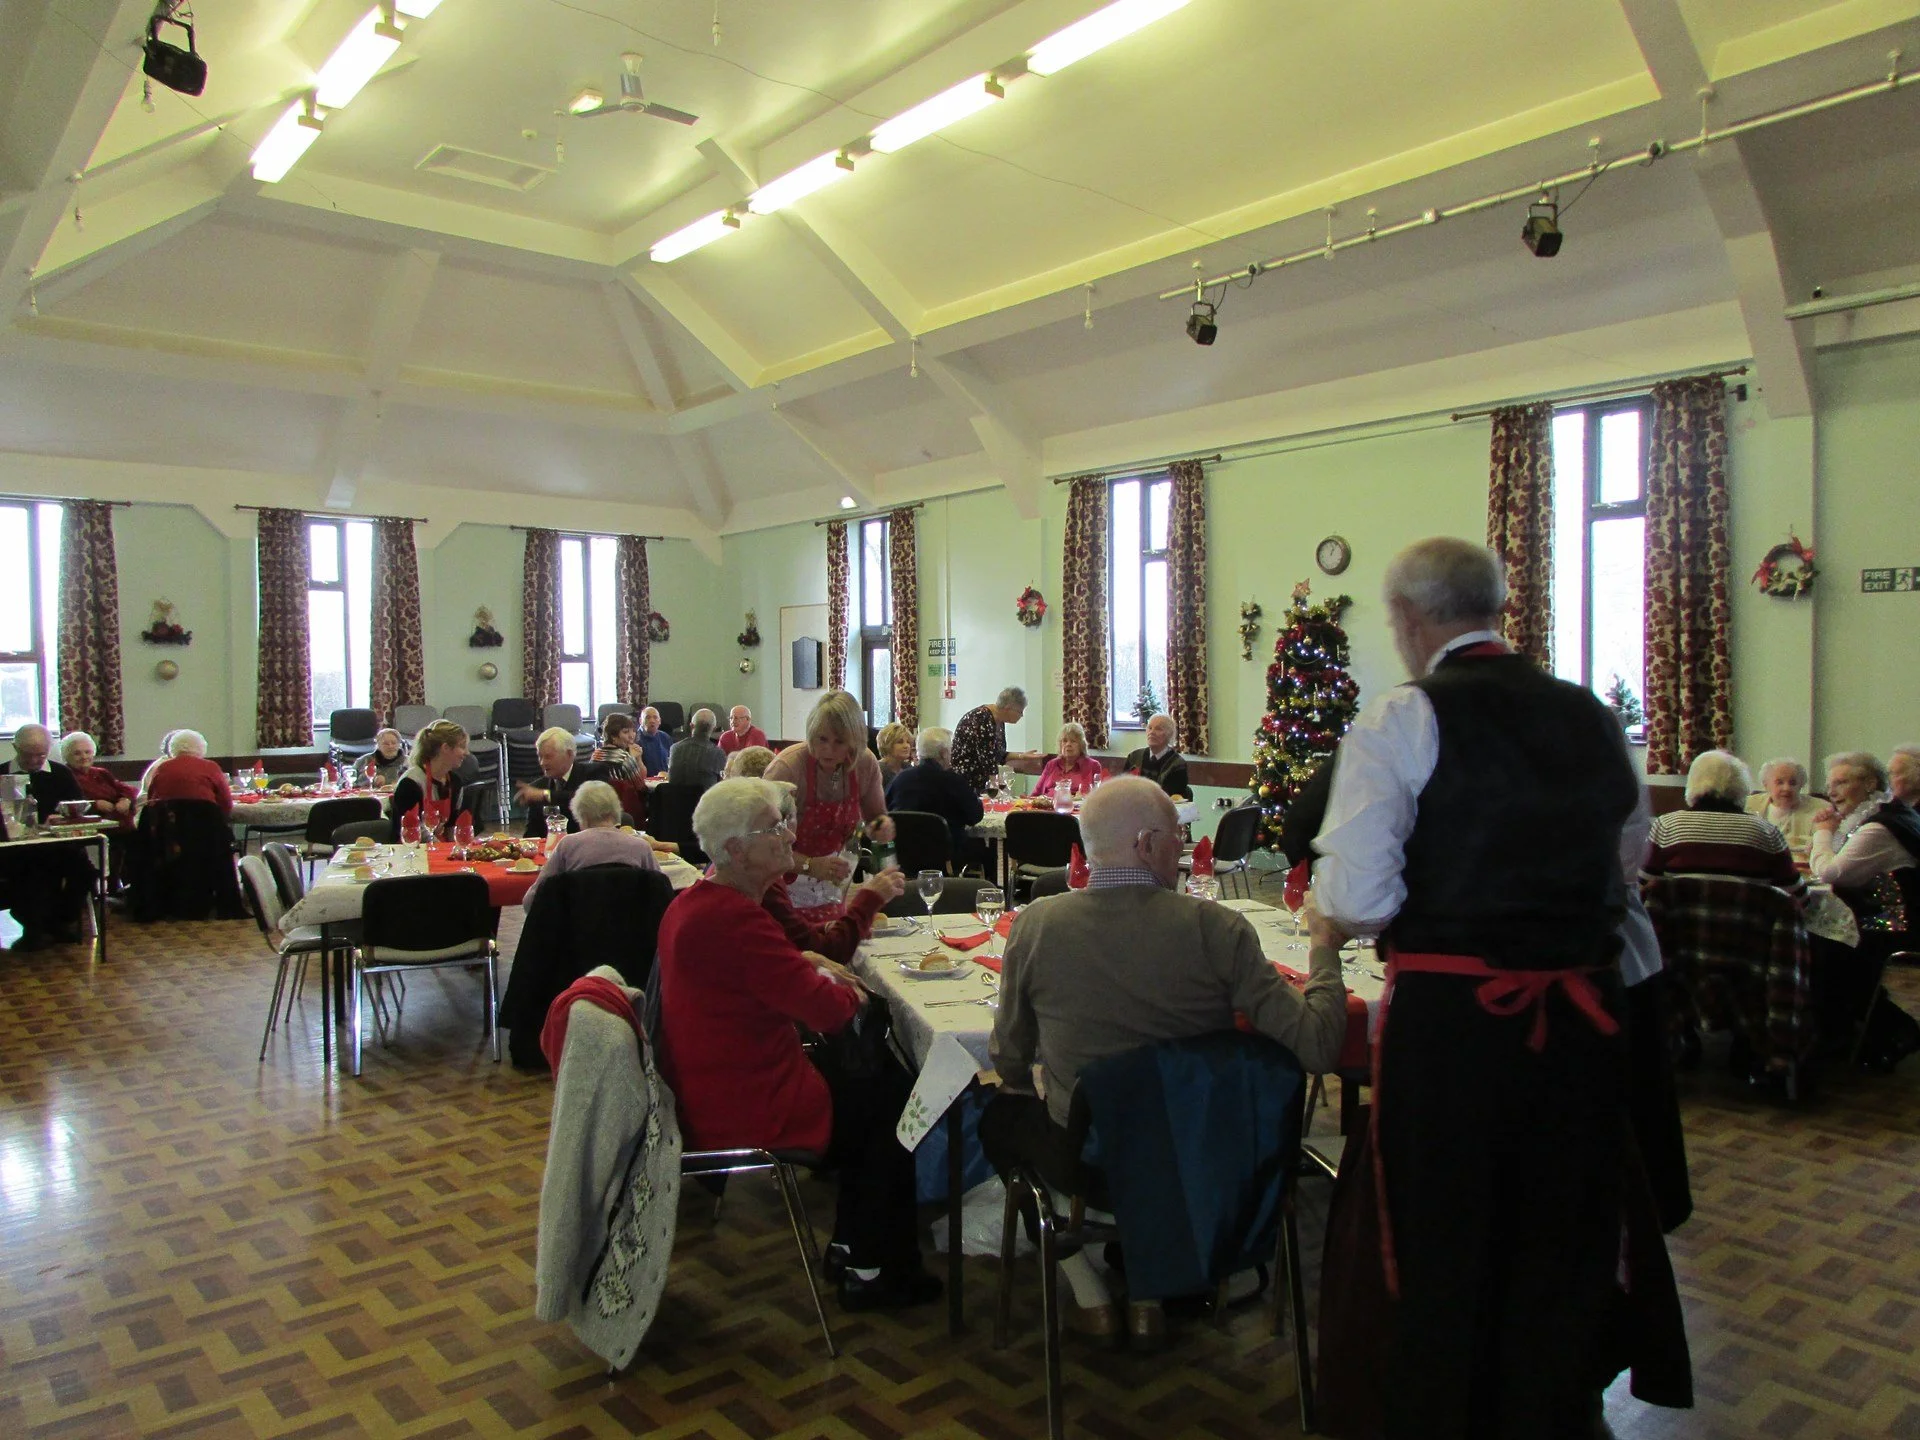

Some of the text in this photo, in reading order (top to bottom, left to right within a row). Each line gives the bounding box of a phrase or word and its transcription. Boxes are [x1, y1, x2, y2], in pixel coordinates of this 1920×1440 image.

[1864, 571, 1891, 580] FIRE
[1864, 581, 1890, 591] EXIT
[929, 640, 942, 648] FIRE
